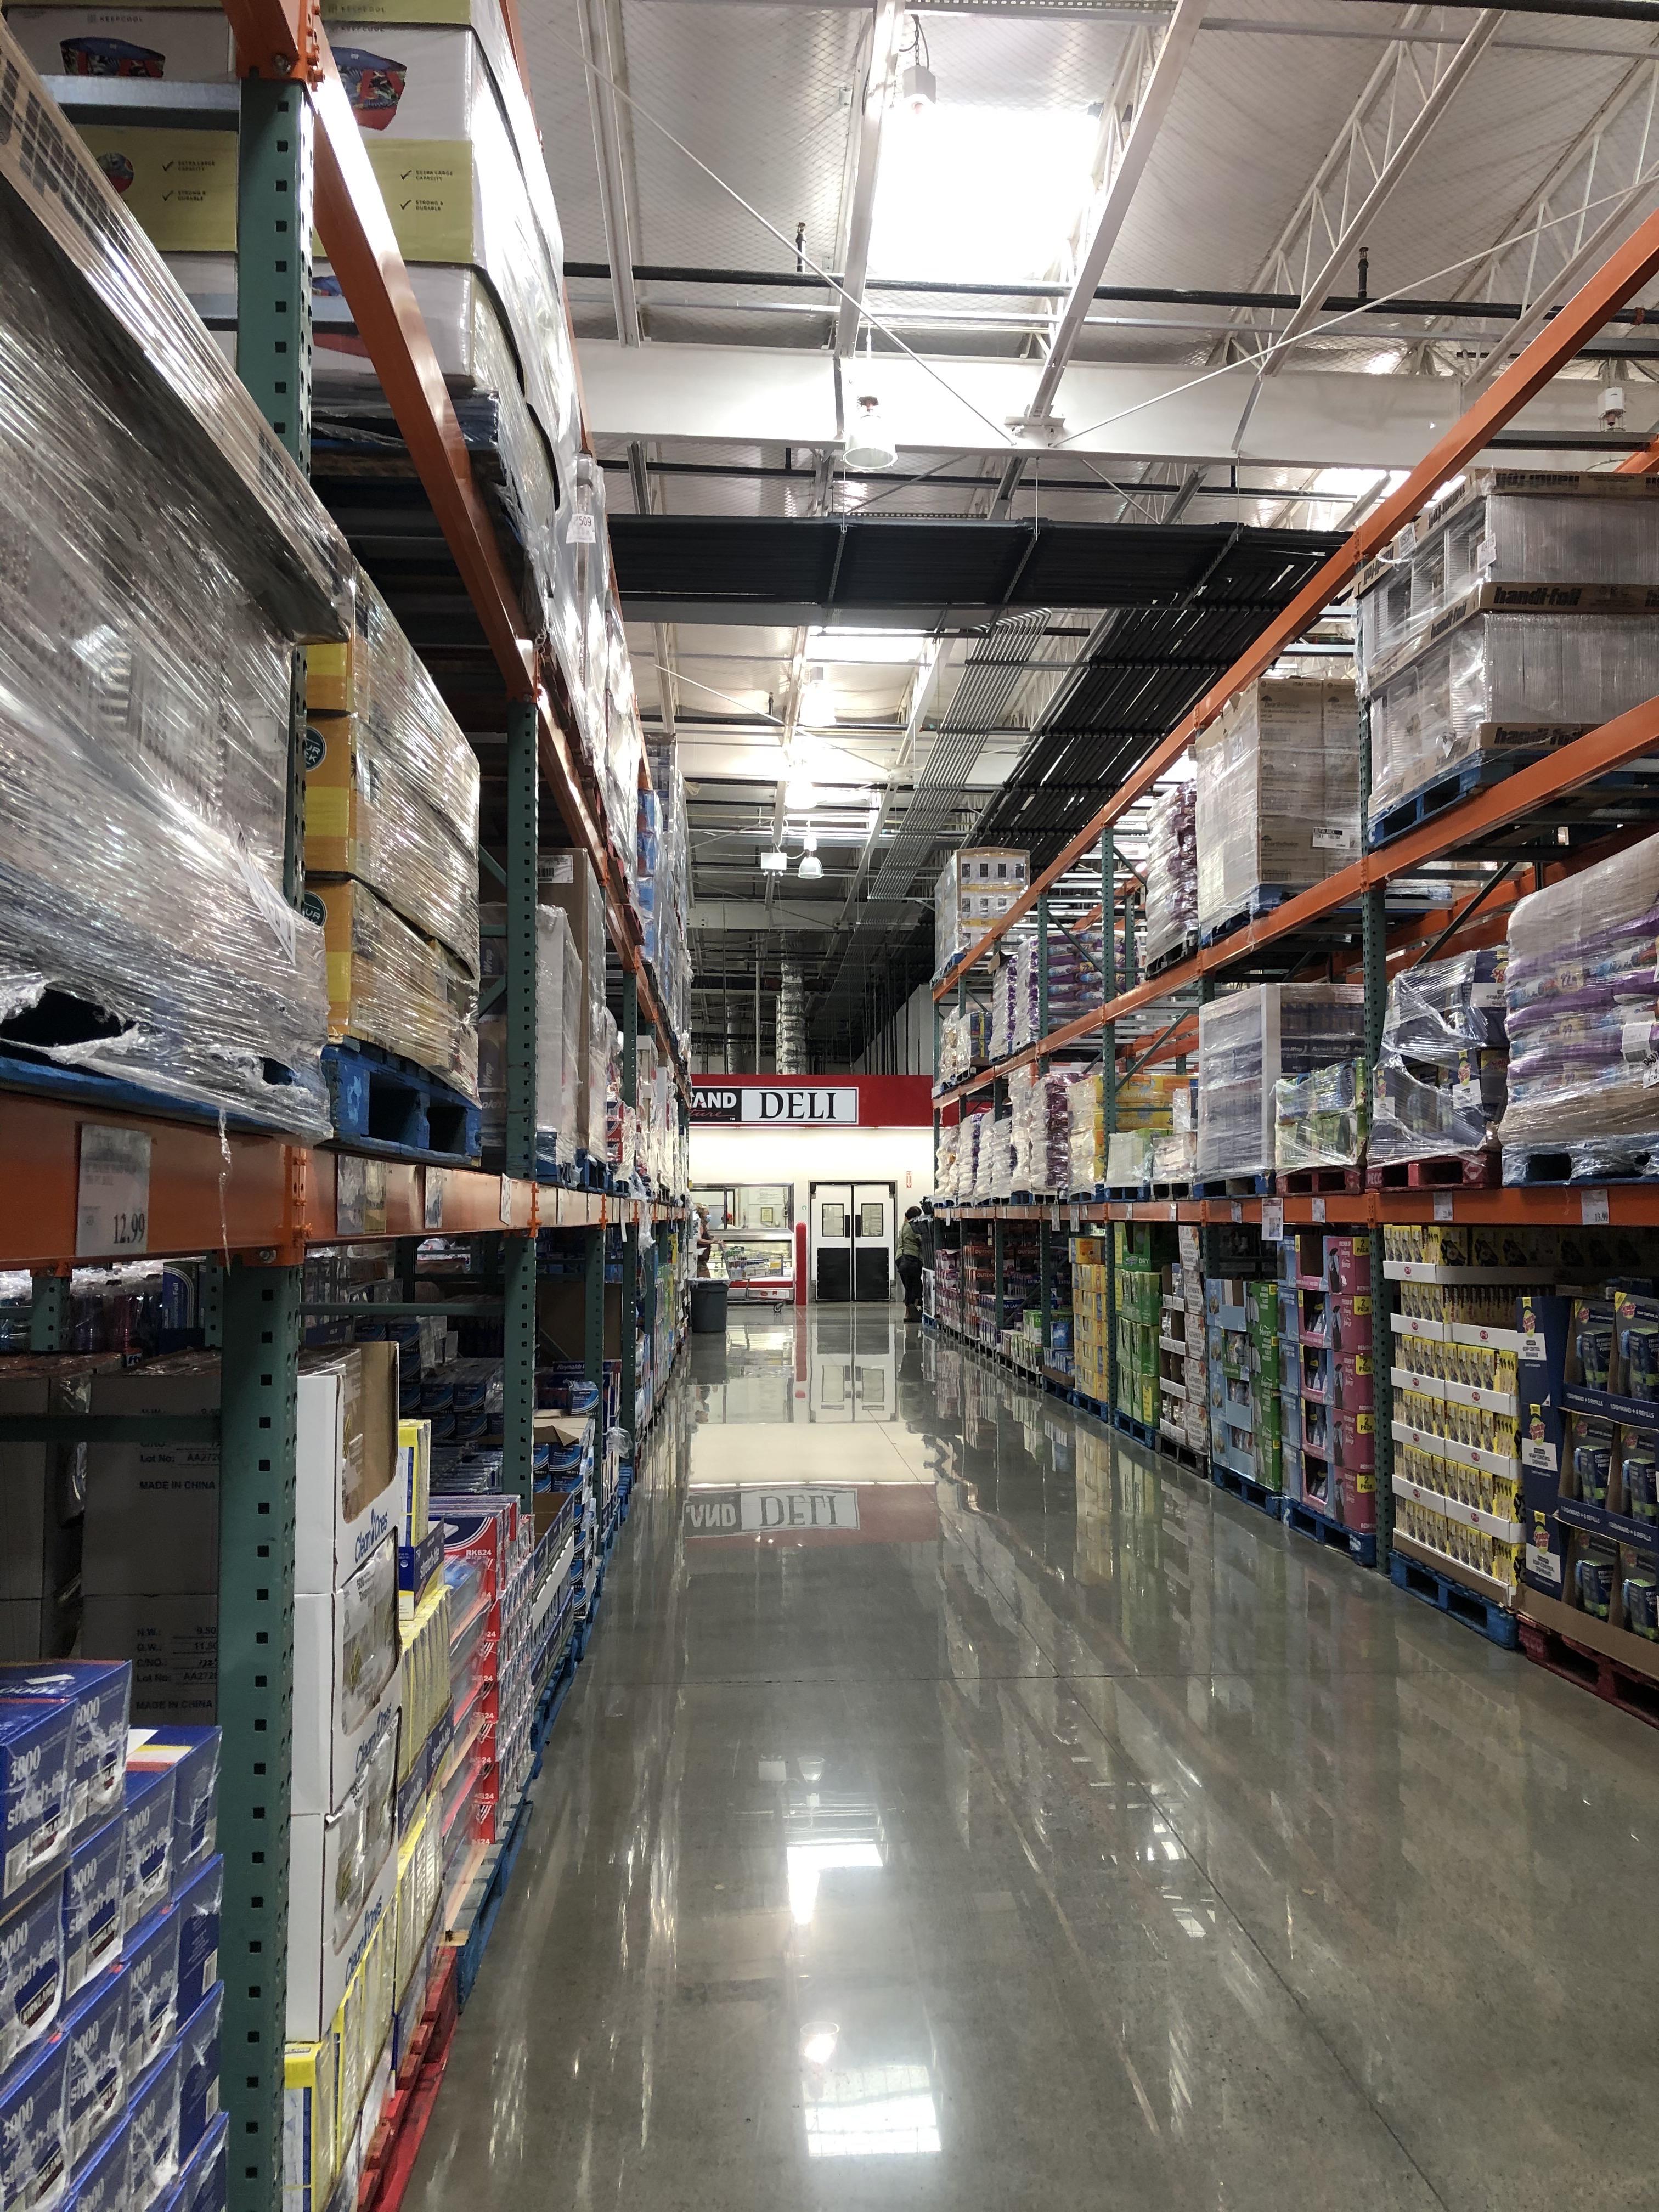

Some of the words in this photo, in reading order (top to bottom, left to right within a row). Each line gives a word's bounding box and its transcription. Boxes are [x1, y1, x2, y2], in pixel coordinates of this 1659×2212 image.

[690, 1092, 737, 1108] AND
[759, 1092, 837, 1119] DELI
[689, 1108, 736, 1118] ture
[1594, 1212, 1609, 1222] 13.99
[113, 1213, 145, 1244] 12.99
[1360, 1239, 1365, 1247] 2
[1639, 1410, 1655, 1419] REFILLS
[140, 1454, 156, 1463] Lot
[187, 1453, 219, 1462] AA272
[140, 1481, 169, 1489] MADE
[172, 1481, 181, 1489] IN
[184, 1481, 216, 1489] CHINA
[136, 1674, 153, 1682] Lot
[184, 1672, 217, 1681] AA272
[136, 1701, 166, 1710] MADE
[168, 1701, 178, 1709] IN
[181, 1700, 212, 1709] CHINA
